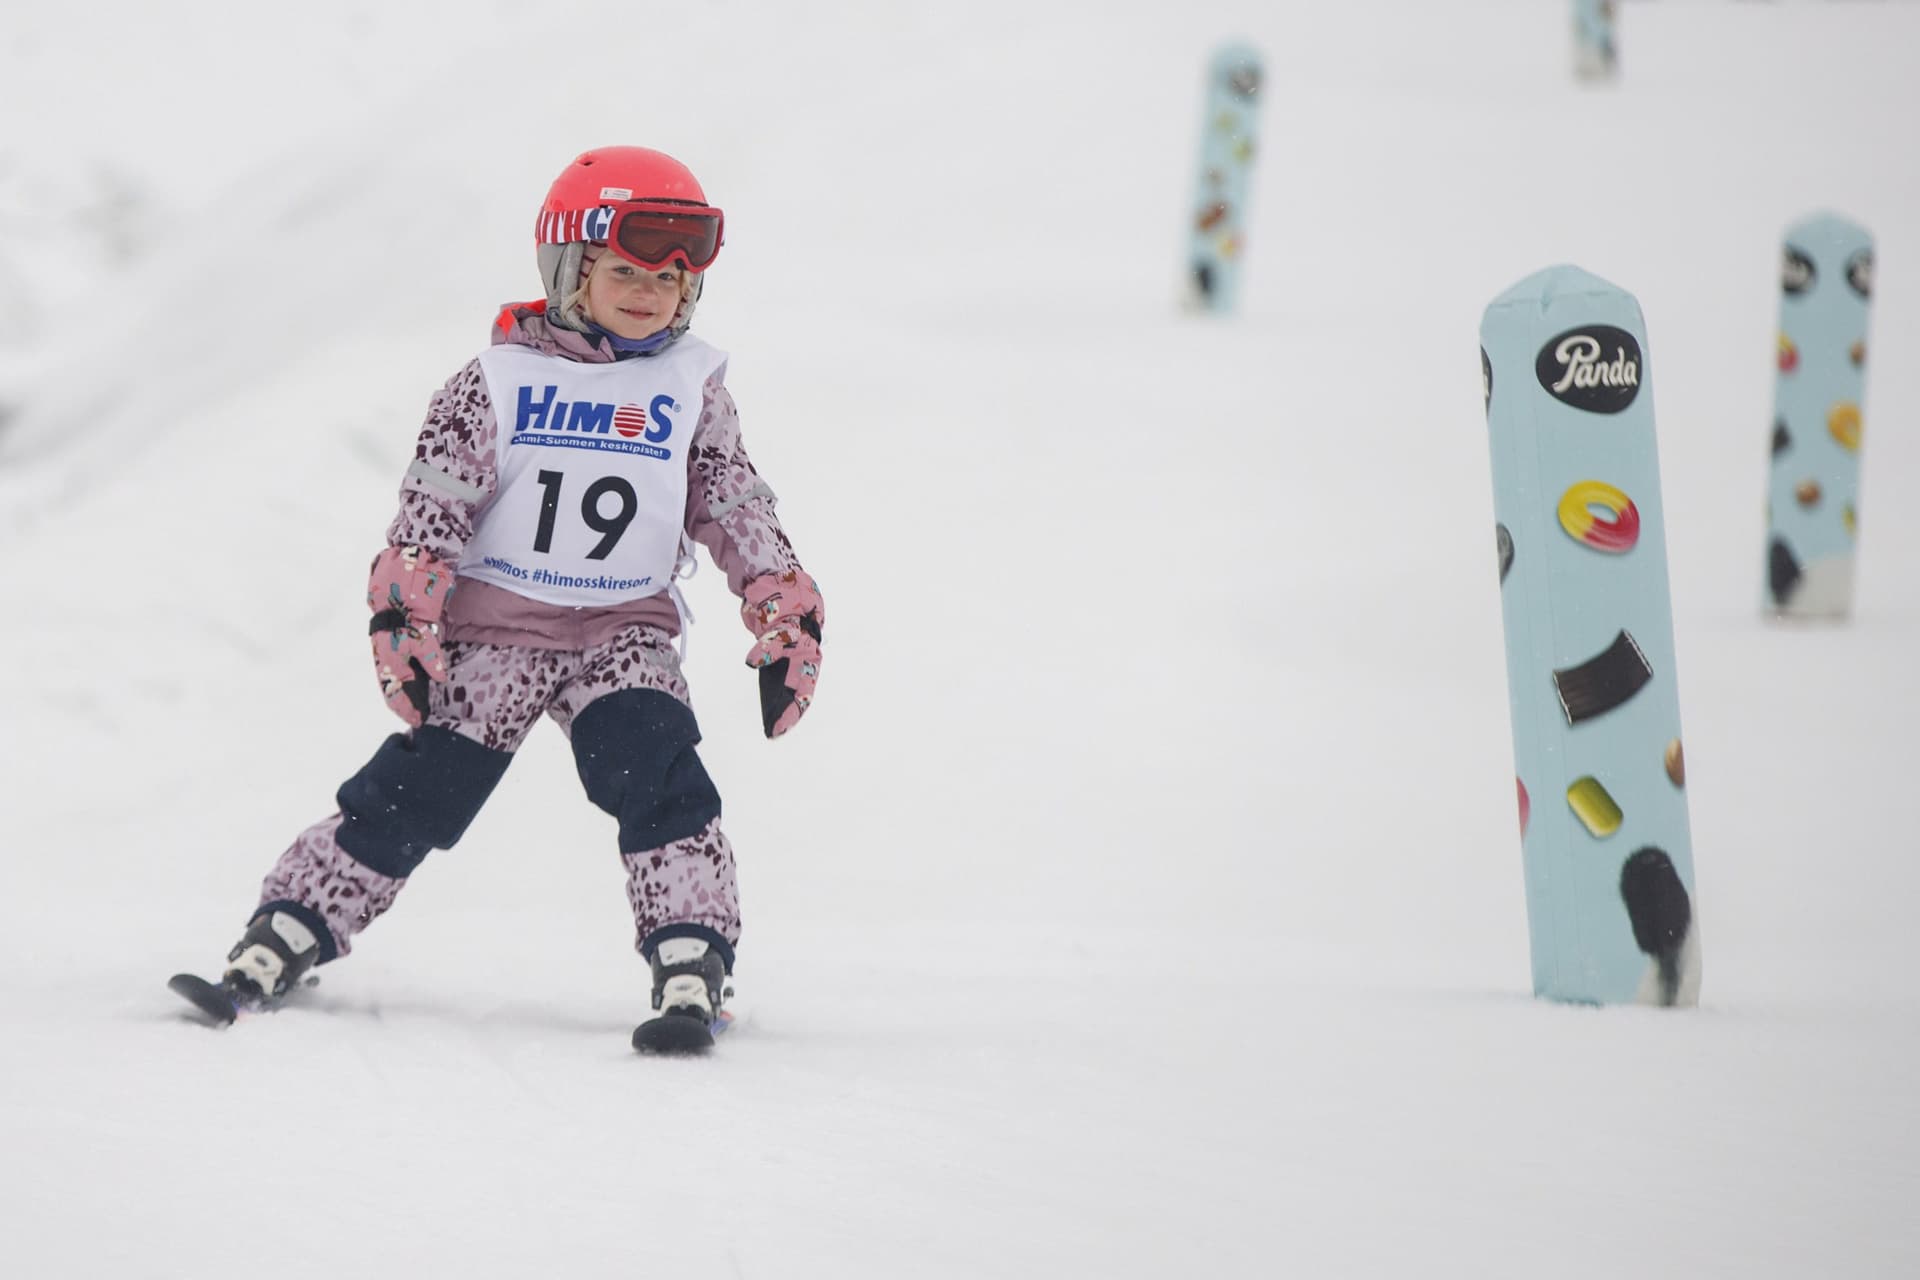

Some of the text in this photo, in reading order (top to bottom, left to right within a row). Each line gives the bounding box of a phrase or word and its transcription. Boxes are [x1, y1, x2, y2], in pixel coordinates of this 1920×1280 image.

[1552, 335, 1638, 394] Panda
[512, 434, 664, 457] umi-Suomen keskipiste!
[533, 469, 638, 560] 19
[532, 568, 652, 590] #himosskiresort
